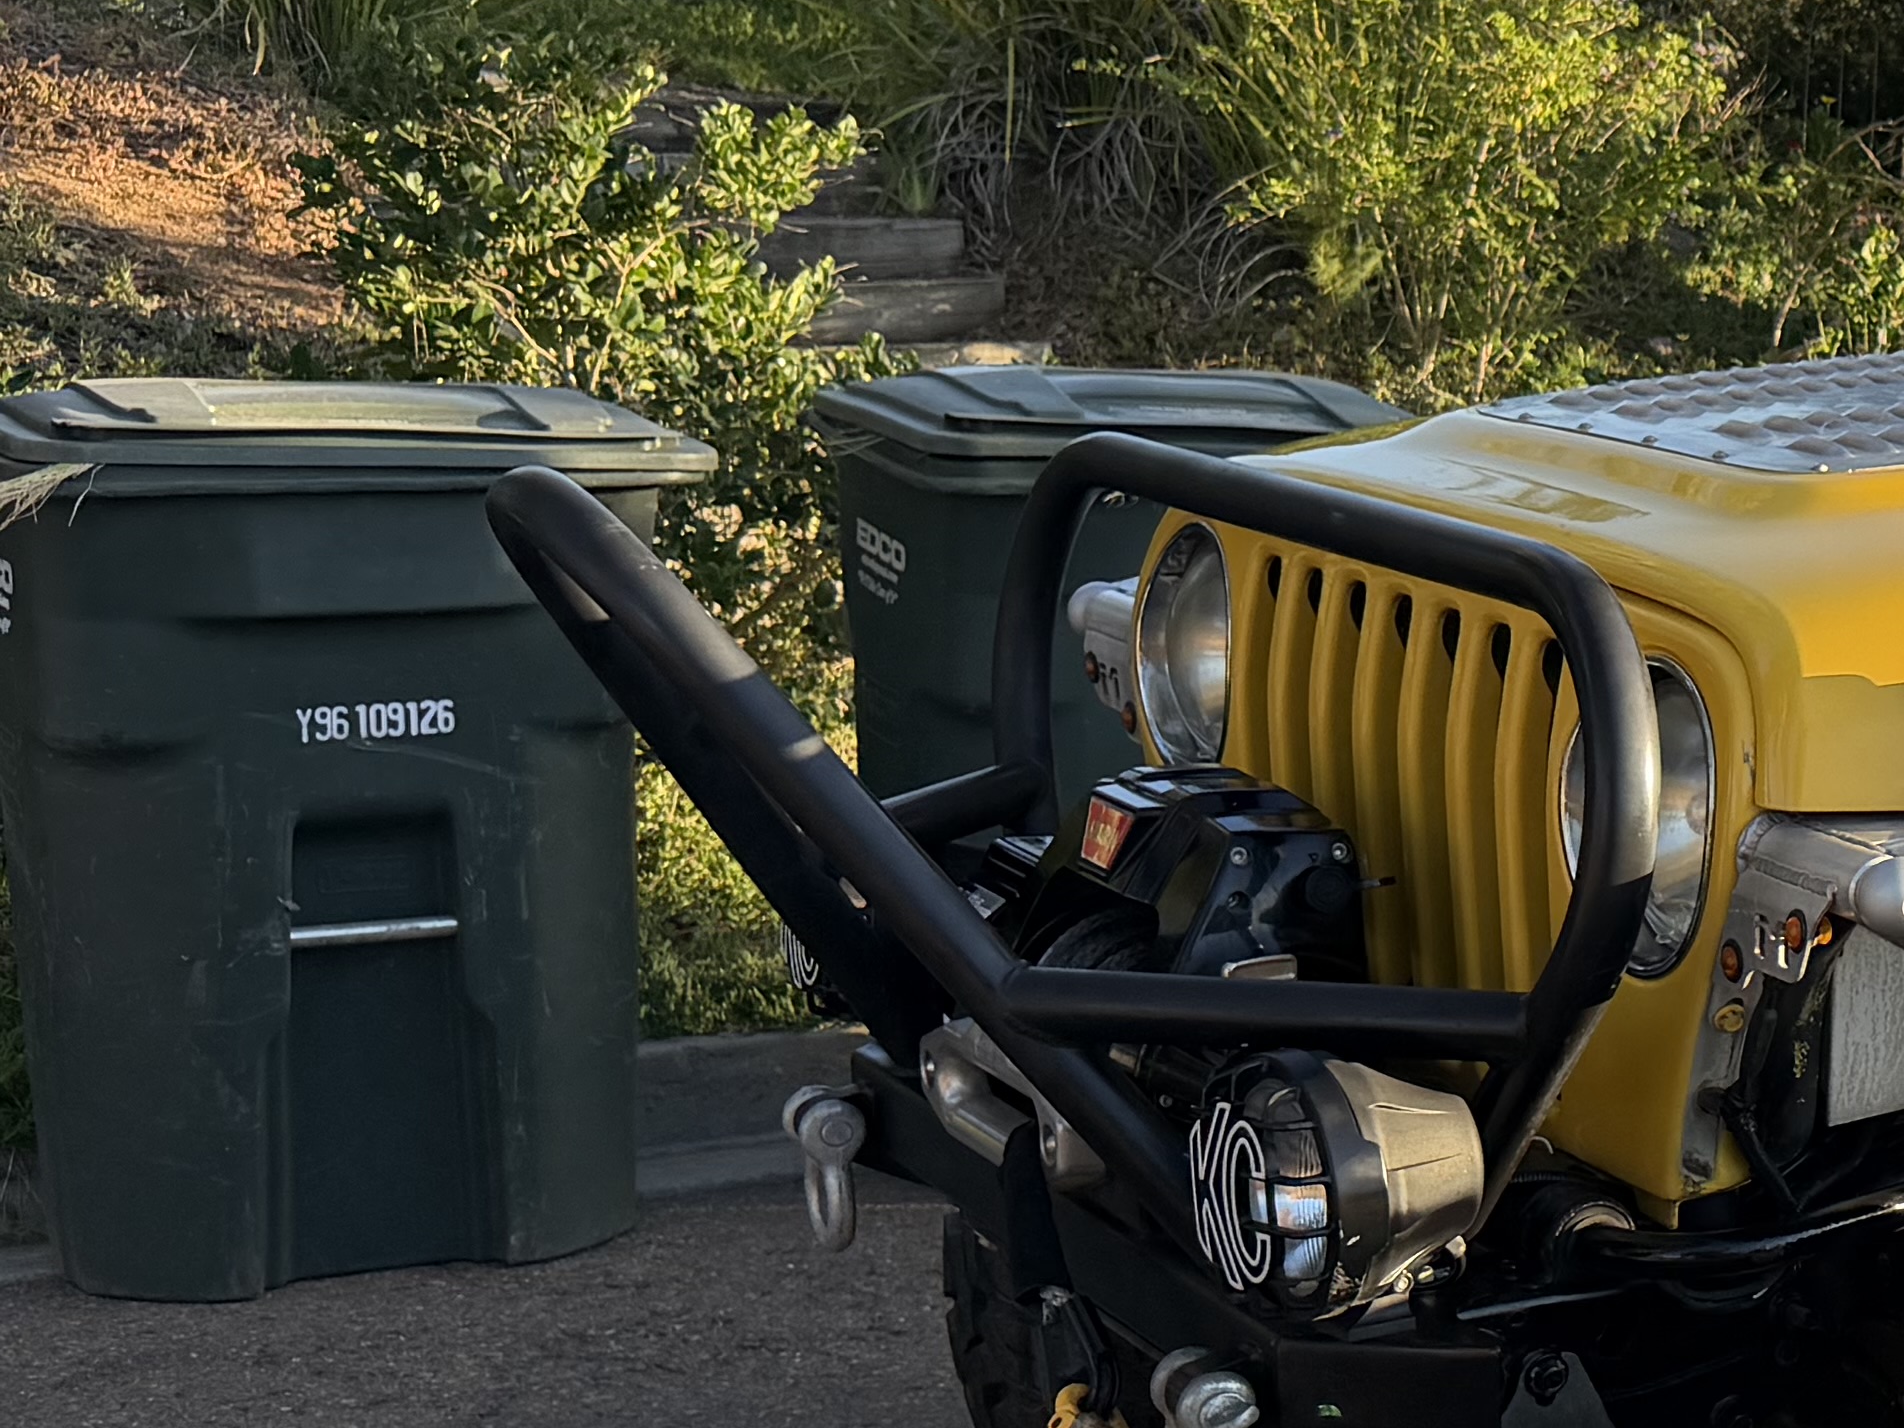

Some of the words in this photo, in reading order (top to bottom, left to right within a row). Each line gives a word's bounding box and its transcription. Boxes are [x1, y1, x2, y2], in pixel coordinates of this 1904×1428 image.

[296, 706, 350, 744] Y96
[355, 699, 455, 739] 109126
[1189, 1102, 1271, 1290] KC
